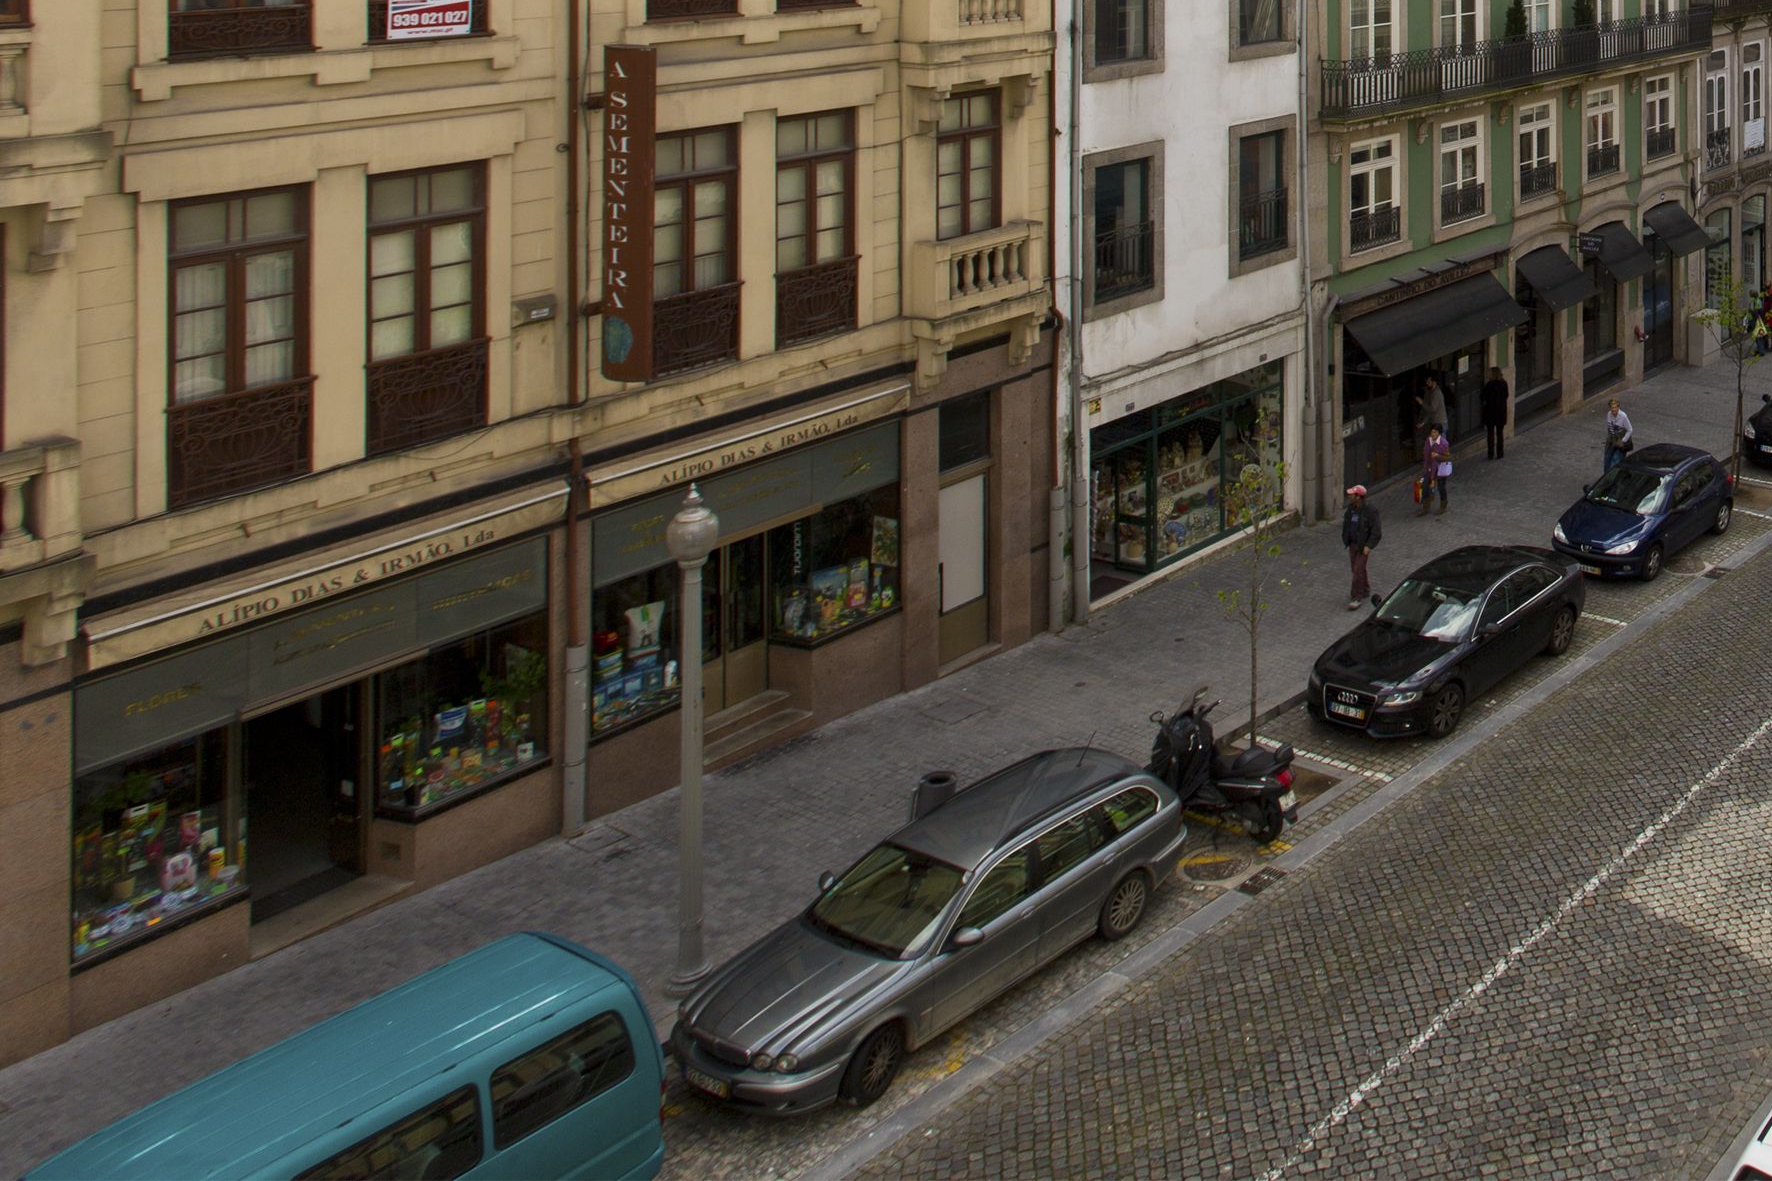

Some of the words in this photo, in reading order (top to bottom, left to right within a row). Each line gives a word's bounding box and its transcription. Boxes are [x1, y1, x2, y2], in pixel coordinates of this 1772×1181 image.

[393, 14, 419, 27] 939
[421, 12, 443, 25] 021
[445, 10, 467, 24] 027
[609, 61, 628, 78] A
[607, 90, 631, 309] SEMENTEIRA
[659, 459, 713, 486] ALÍPIO
[721, 447, 756, 466] DIAS
[762, 440, 774, 451] &
[199, 596, 280, 634] ALÍPIO
[291, 576, 343, 605] DIAS
[353, 569, 369, 584] &
[463, 529, 495, 549] Lda
